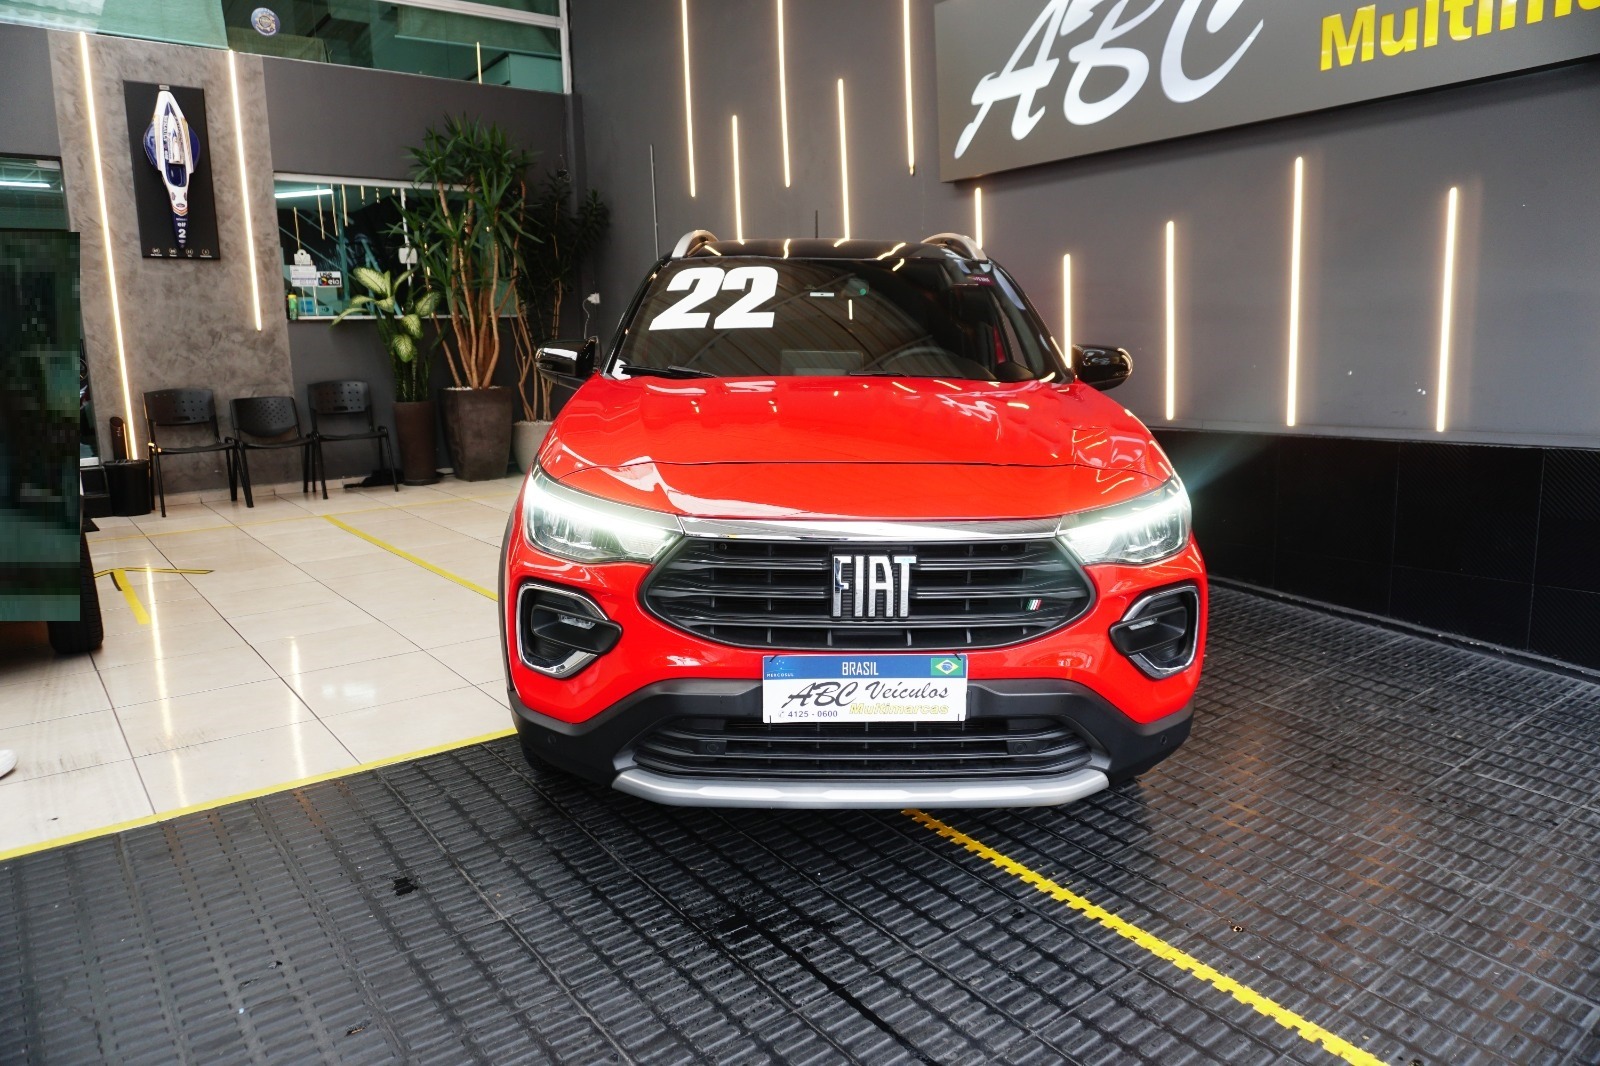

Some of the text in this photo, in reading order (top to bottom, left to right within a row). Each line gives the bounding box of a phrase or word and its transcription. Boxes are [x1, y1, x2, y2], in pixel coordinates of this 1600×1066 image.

[954, 0, 1264, 159] ABC
[178, 228, 187, 239] 2
[647, 265, 779, 331] 22
[832, 554, 918, 618] FIAT
[842, 661, 880, 676] BRASIL
[781, 681, 950, 709] ABC Veículos
[787, 710, 809, 718] 4125
[817, 710, 838, 718] 0600
[849, 702, 950, 715] Multimarcas
